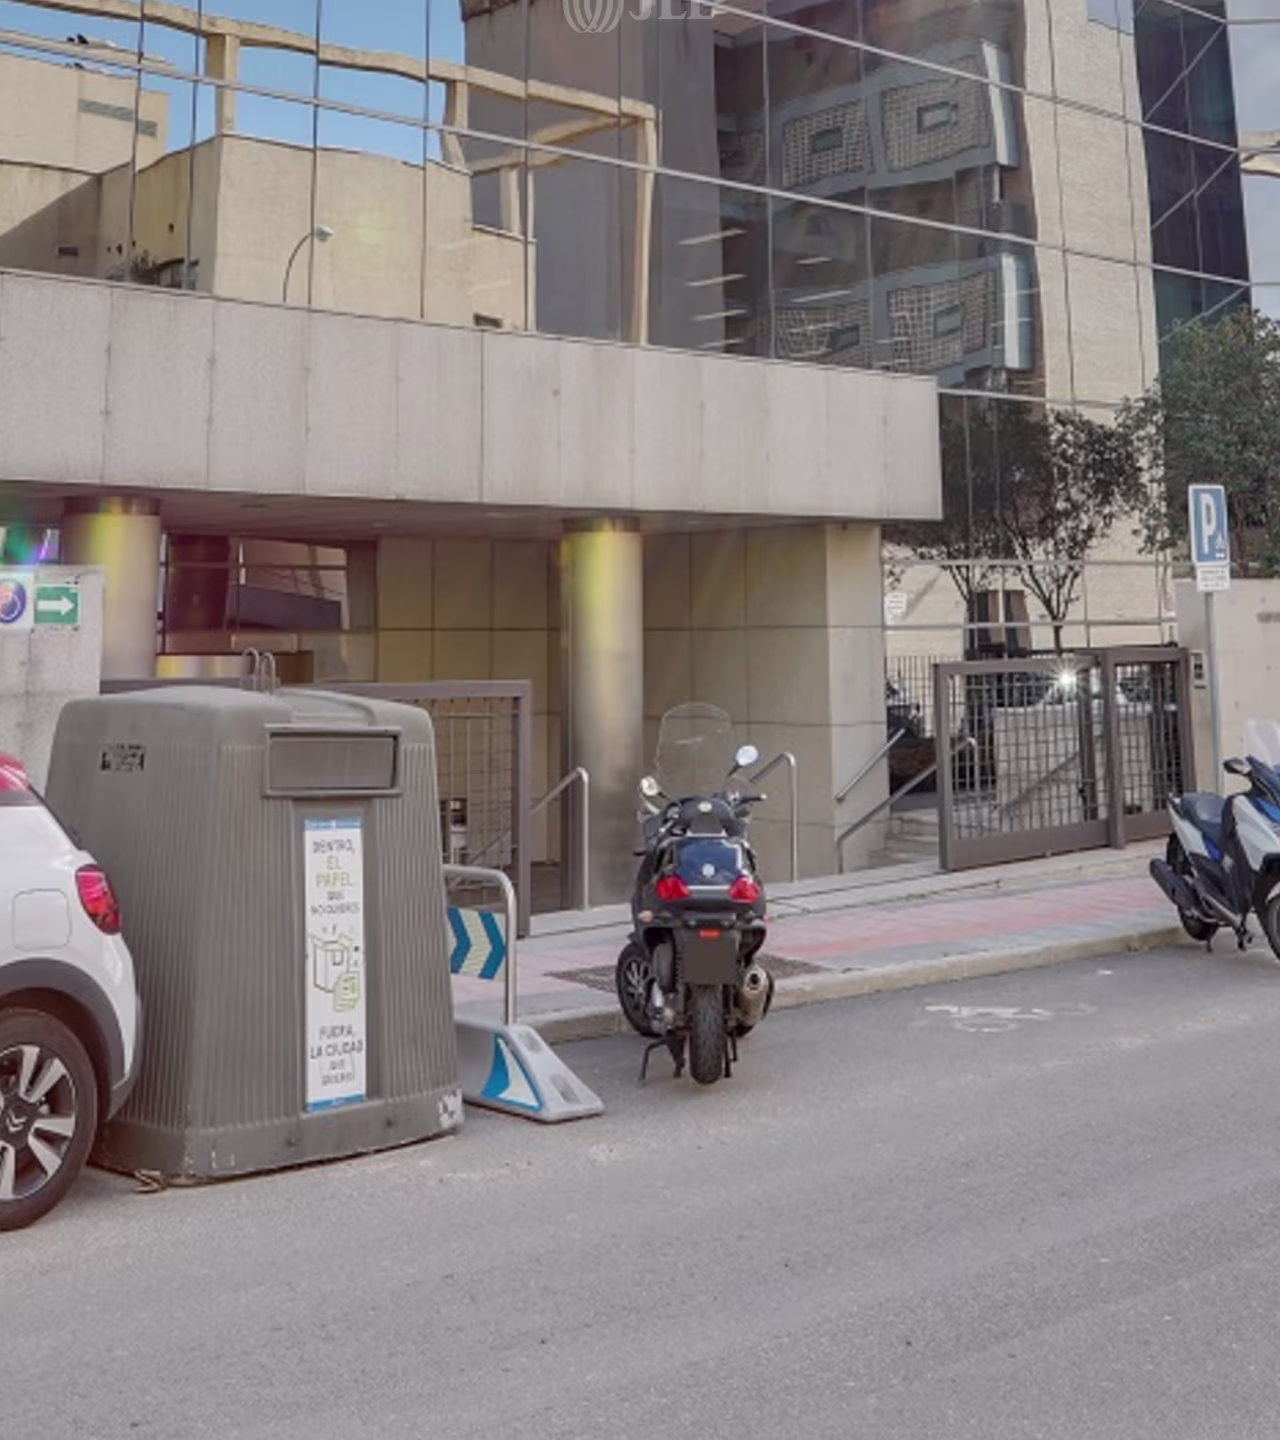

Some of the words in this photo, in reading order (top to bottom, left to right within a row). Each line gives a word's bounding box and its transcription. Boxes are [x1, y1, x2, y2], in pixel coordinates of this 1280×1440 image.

[1200, 493, 1217, 555] P
[326, 855, 342, 870] EL
[315, 871, 353, 888] PAPEL
[309, 1045, 322, 1060] LA
